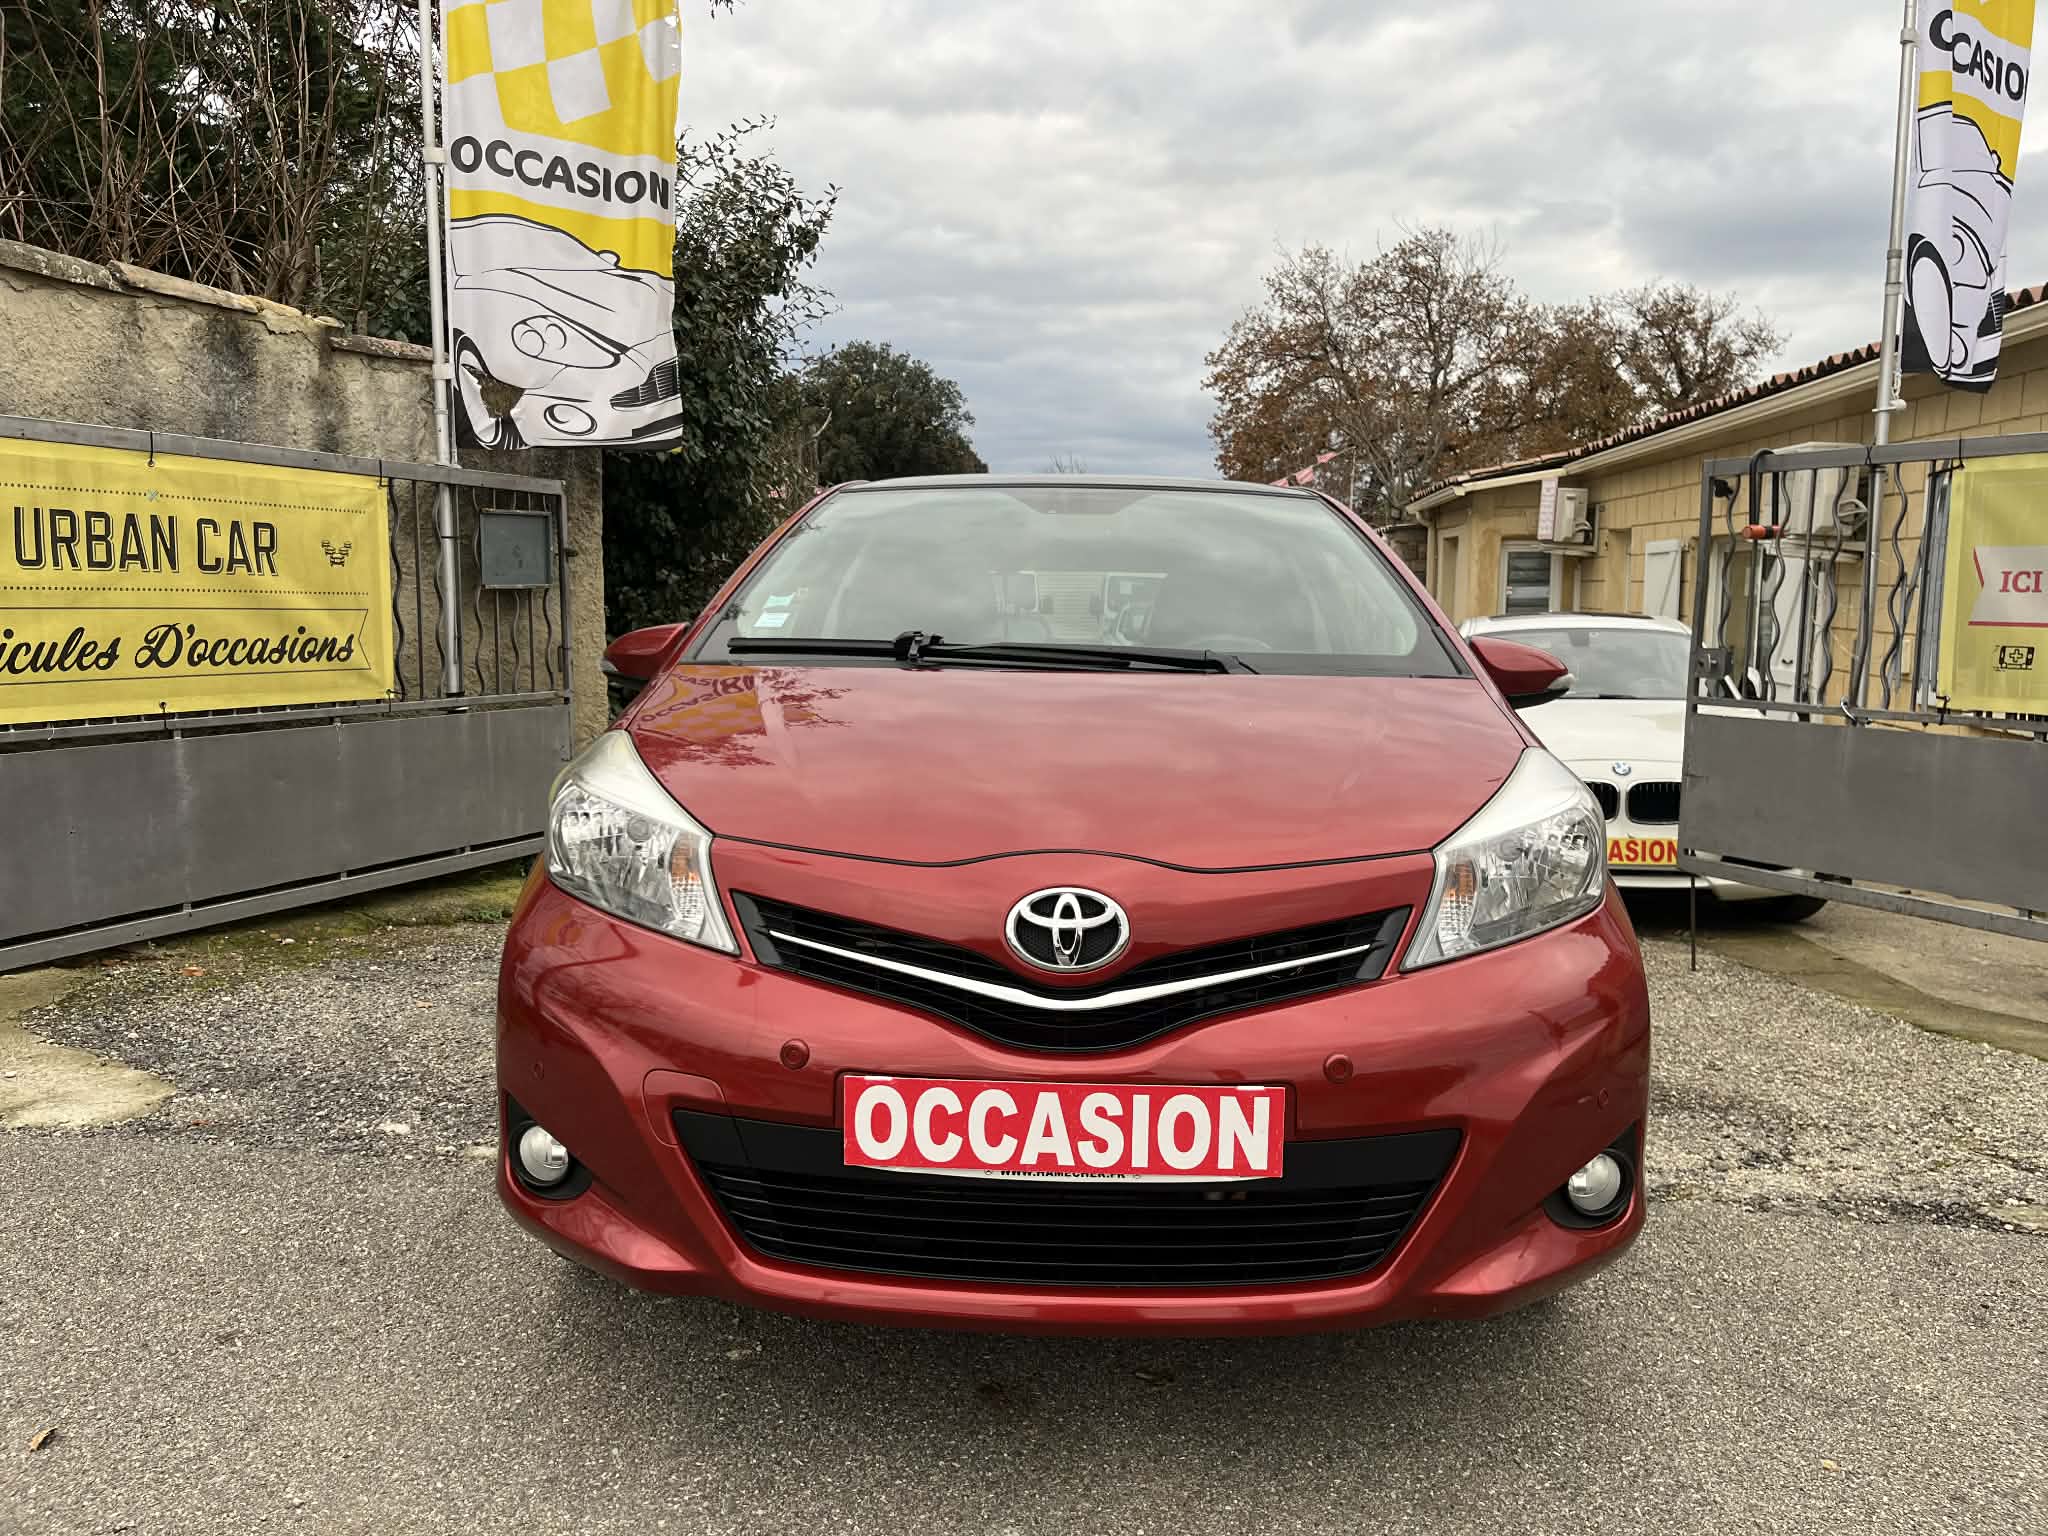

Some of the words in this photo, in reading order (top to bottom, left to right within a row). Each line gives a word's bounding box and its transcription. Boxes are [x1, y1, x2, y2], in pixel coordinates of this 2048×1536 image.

[450, 135, 669, 210] OCCASION
[13, 506, 180, 574] URBAN
[196, 518, 279, 577] CAR
[1999, 570, 2043, 593] ICI
[134, 622, 355, 669] D'occasions
[854, 1084, 1271, 1169] OCCASION
